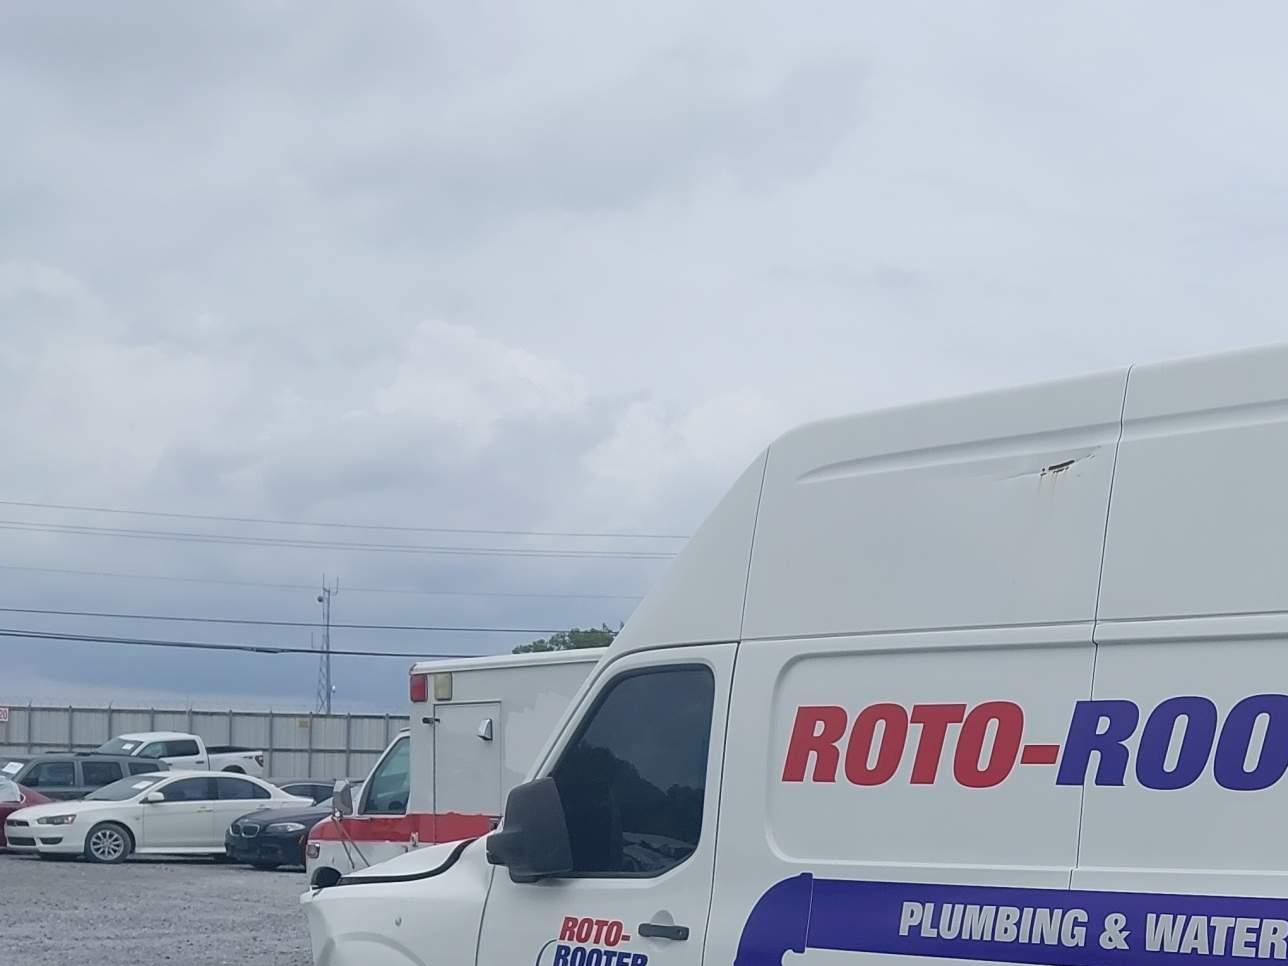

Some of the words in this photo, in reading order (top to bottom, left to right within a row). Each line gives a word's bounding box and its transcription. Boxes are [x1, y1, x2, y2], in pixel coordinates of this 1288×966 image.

[559, 916, 630, 946] ROTO-
[898, 900, 1087, 949] PLUMBING
[1098, 912, 1131, 950] &
[1144, 914, 1288, 963] WATER
